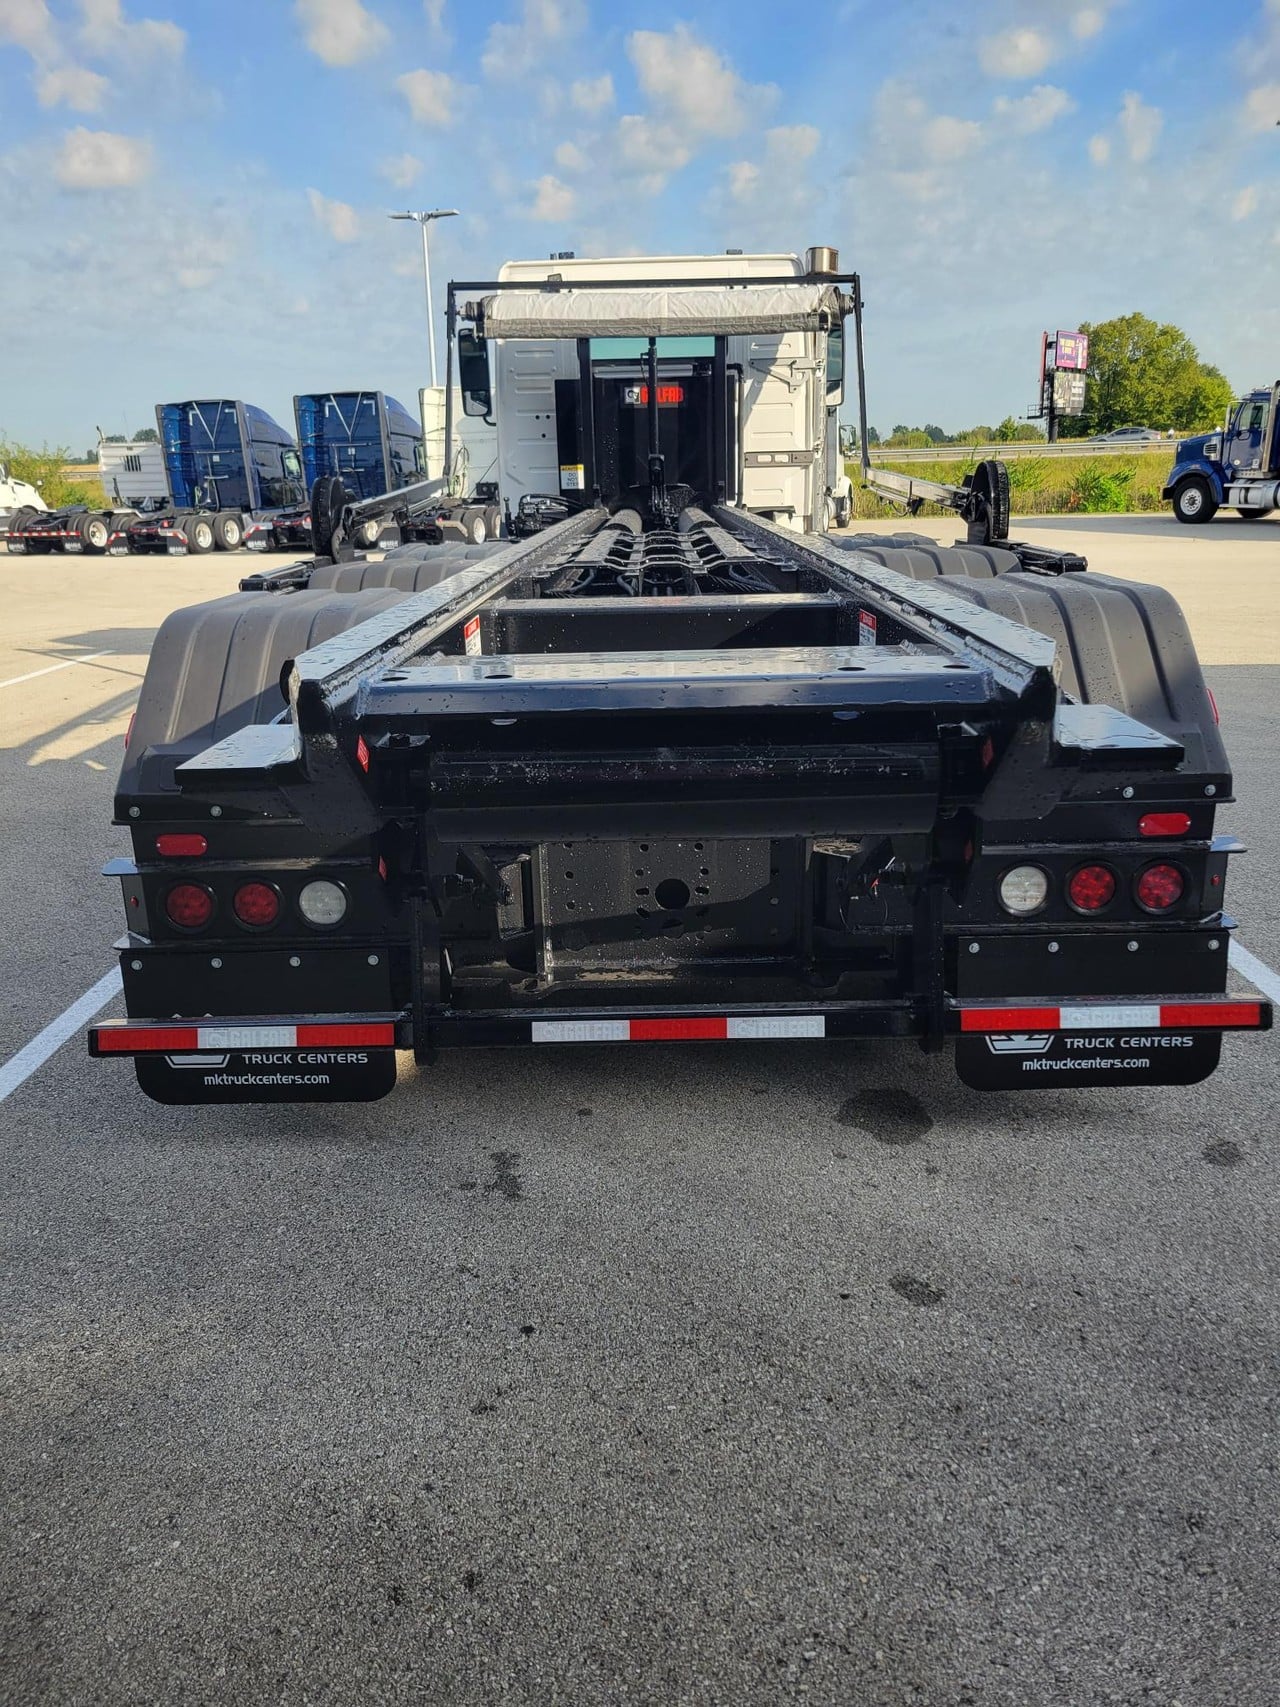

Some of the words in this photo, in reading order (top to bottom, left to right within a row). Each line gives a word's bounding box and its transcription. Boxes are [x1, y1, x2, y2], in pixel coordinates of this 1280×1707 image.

[640, 385, 683, 402] GLFAB
[1064, 1037, 1115, 1049] TRUCK
[1120, 1036, 1193, 1048] CENTERS
[242, 1053, 293, 1065] TRUCK
[297, 1053, 369, 1064] CENTERS
[1022, 1057, 1150, 1071] mktruckcenters.com
[204, 1073, 330, 1086] mktruckcenters.com
